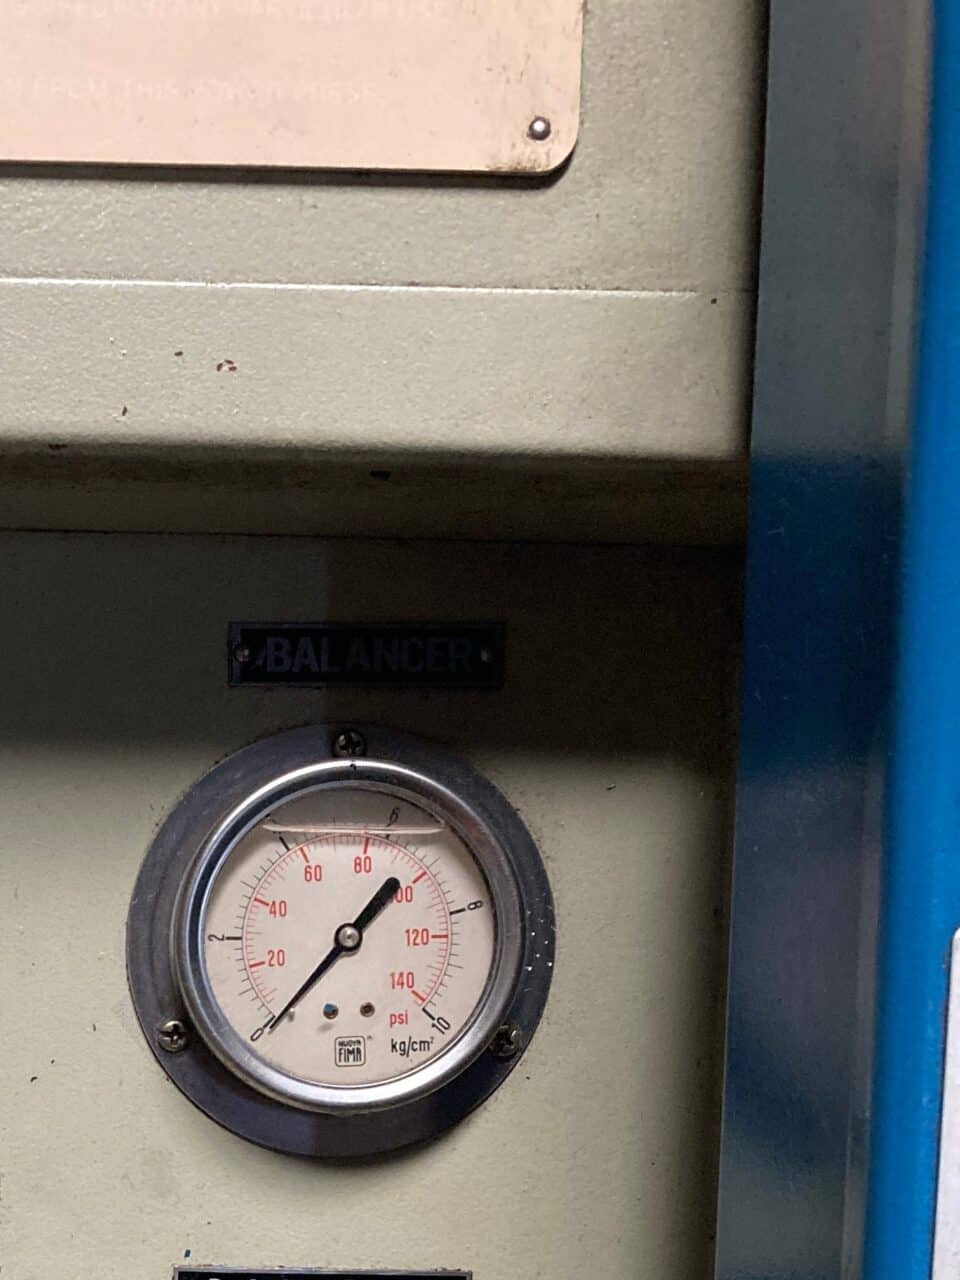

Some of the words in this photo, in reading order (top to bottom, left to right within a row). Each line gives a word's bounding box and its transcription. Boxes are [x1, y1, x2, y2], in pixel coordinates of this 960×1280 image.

[266, 636, 473, 673] BALANCER
[304, 865, 323, 882] 60
[354, 857, 372, 873] 80
[391, 886, 413, 903] 00
[269, 901, 287, 918] 40
[468, 901, 484, 910] 8
[207, 934, 225, 942] 2
[405, 929, 430, 946] 120
[267, 950, 286, 967] 20
[390, 972, 415, 989] 140
[390, 1010, 408, 1028] psi
[431, 1017, 451, 1035] 10
[250, 1028, 264, 1042] 0
